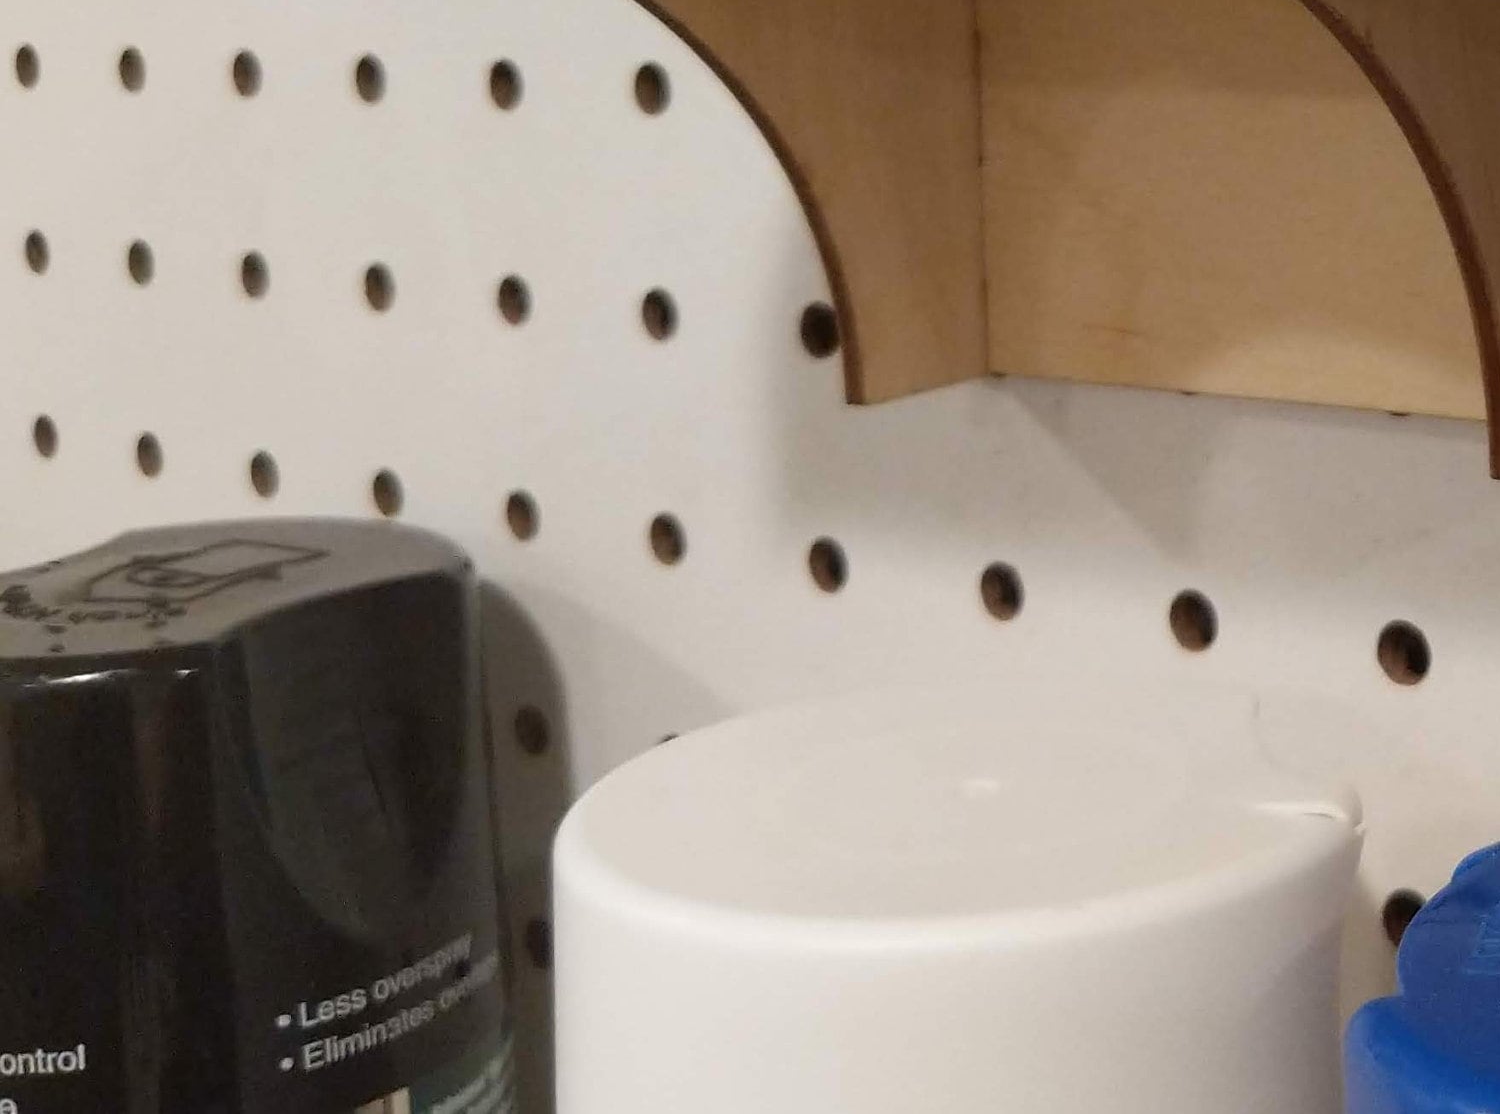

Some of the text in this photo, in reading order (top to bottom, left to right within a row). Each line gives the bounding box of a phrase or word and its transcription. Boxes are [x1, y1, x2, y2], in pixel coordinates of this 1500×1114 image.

[299, 988, 368, 1028] Less
[372, 933, 472, 1002] oversp
[0, 1043, 86, 1076] ontrol
